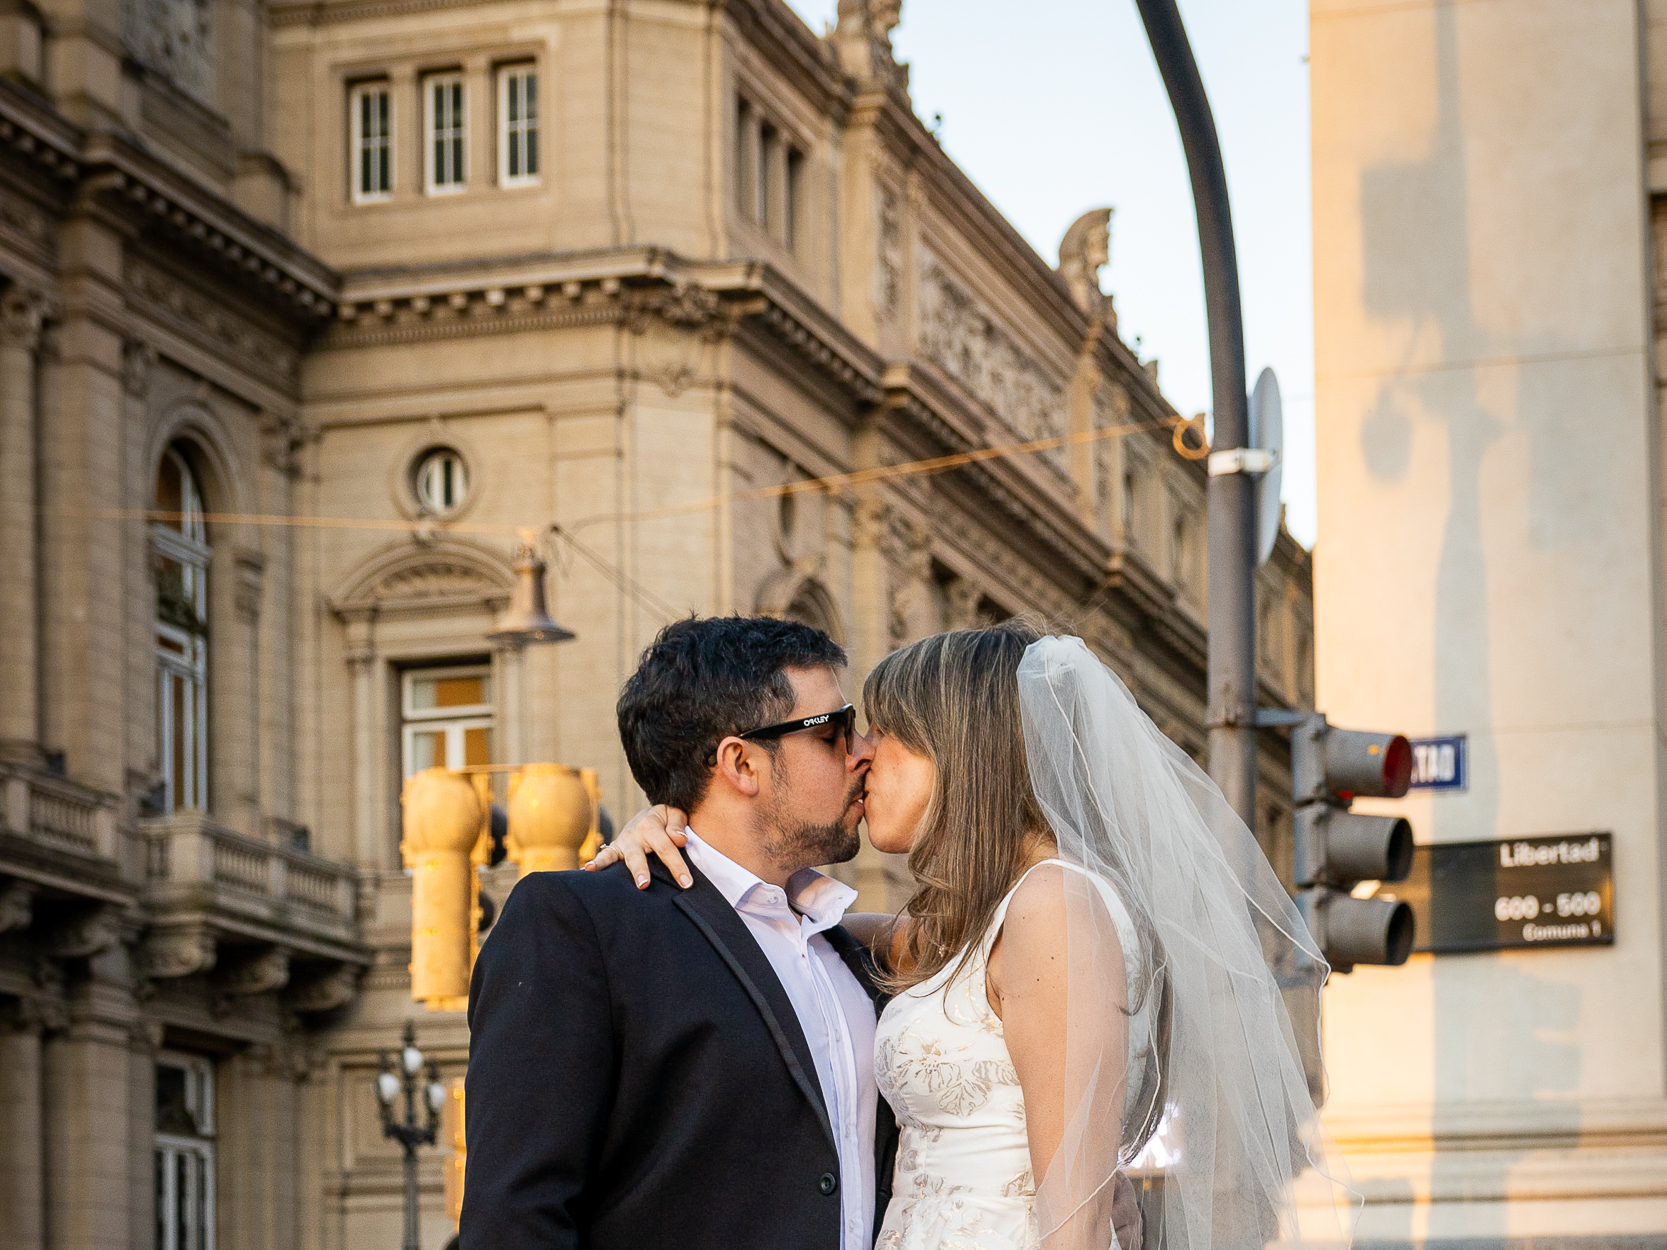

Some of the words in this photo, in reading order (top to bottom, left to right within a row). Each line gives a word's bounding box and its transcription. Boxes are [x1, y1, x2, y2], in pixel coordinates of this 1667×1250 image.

[803, 714, 830, 727] OAKLEY
[1411, 744, 1456, 783] TAD
[1500, 837, 1599, 868] Libertad
[1494, 894, 1540, 921] 600
[1556, 891, 1601, 917] 500
[1522, 922, 1590, 942] Comuna
[1590, 920, 1601, 937] 1
